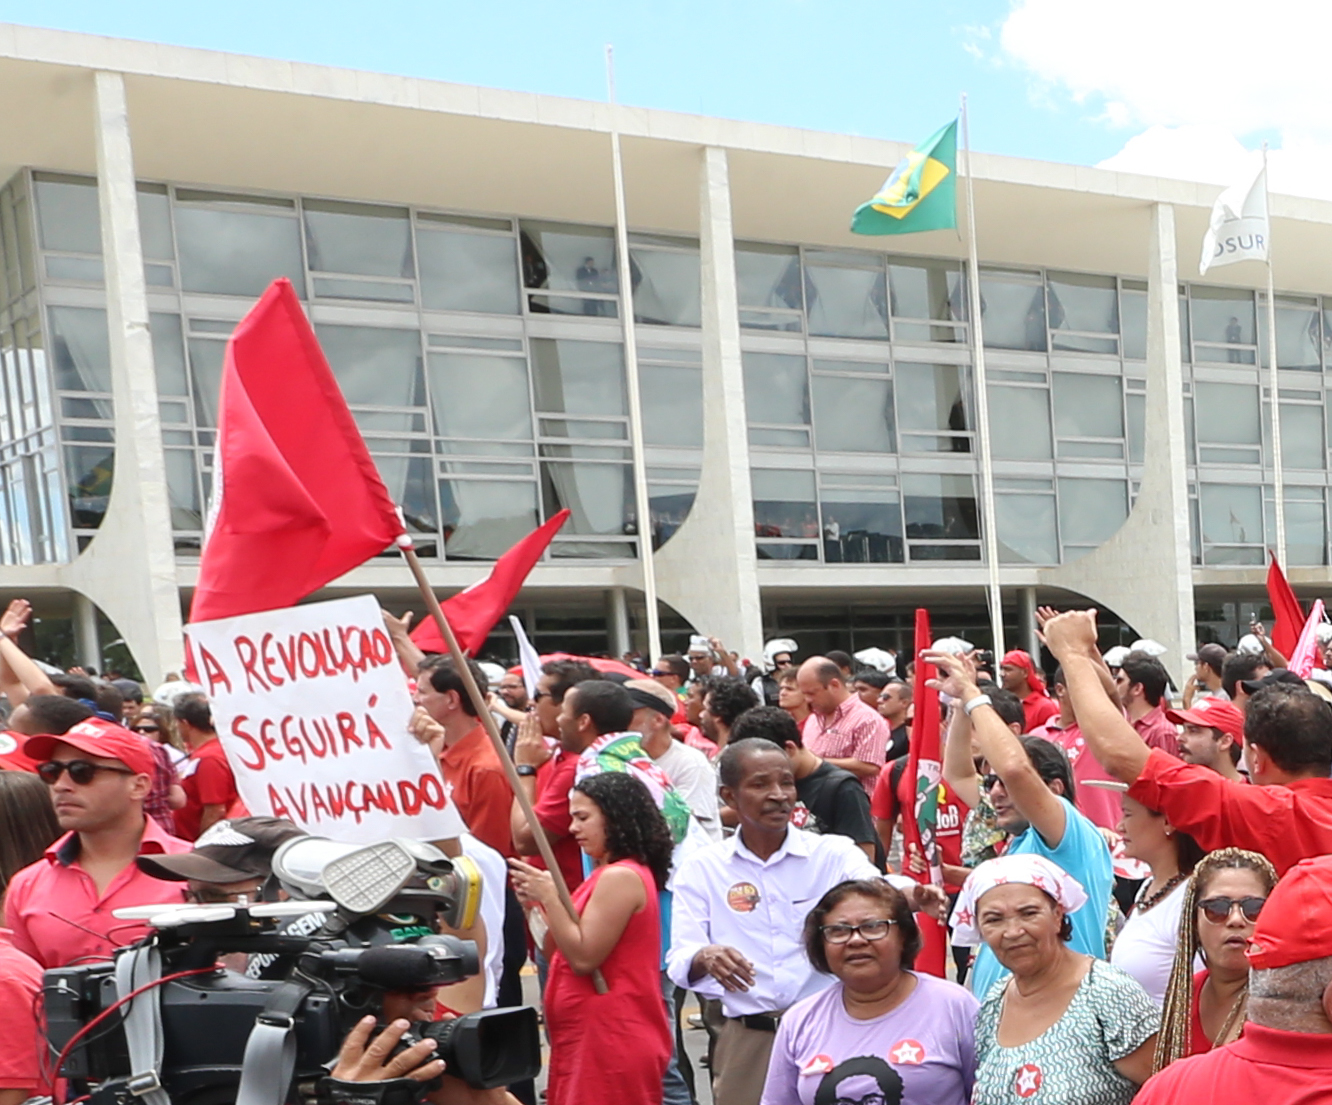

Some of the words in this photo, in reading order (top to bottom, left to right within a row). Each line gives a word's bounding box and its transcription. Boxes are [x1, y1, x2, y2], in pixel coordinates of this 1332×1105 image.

[199, 642, 232, 697] A
[231, 693, 393, 771] SEGUIRÁ
[267, 772, 448, 825] AVANÇANDO
